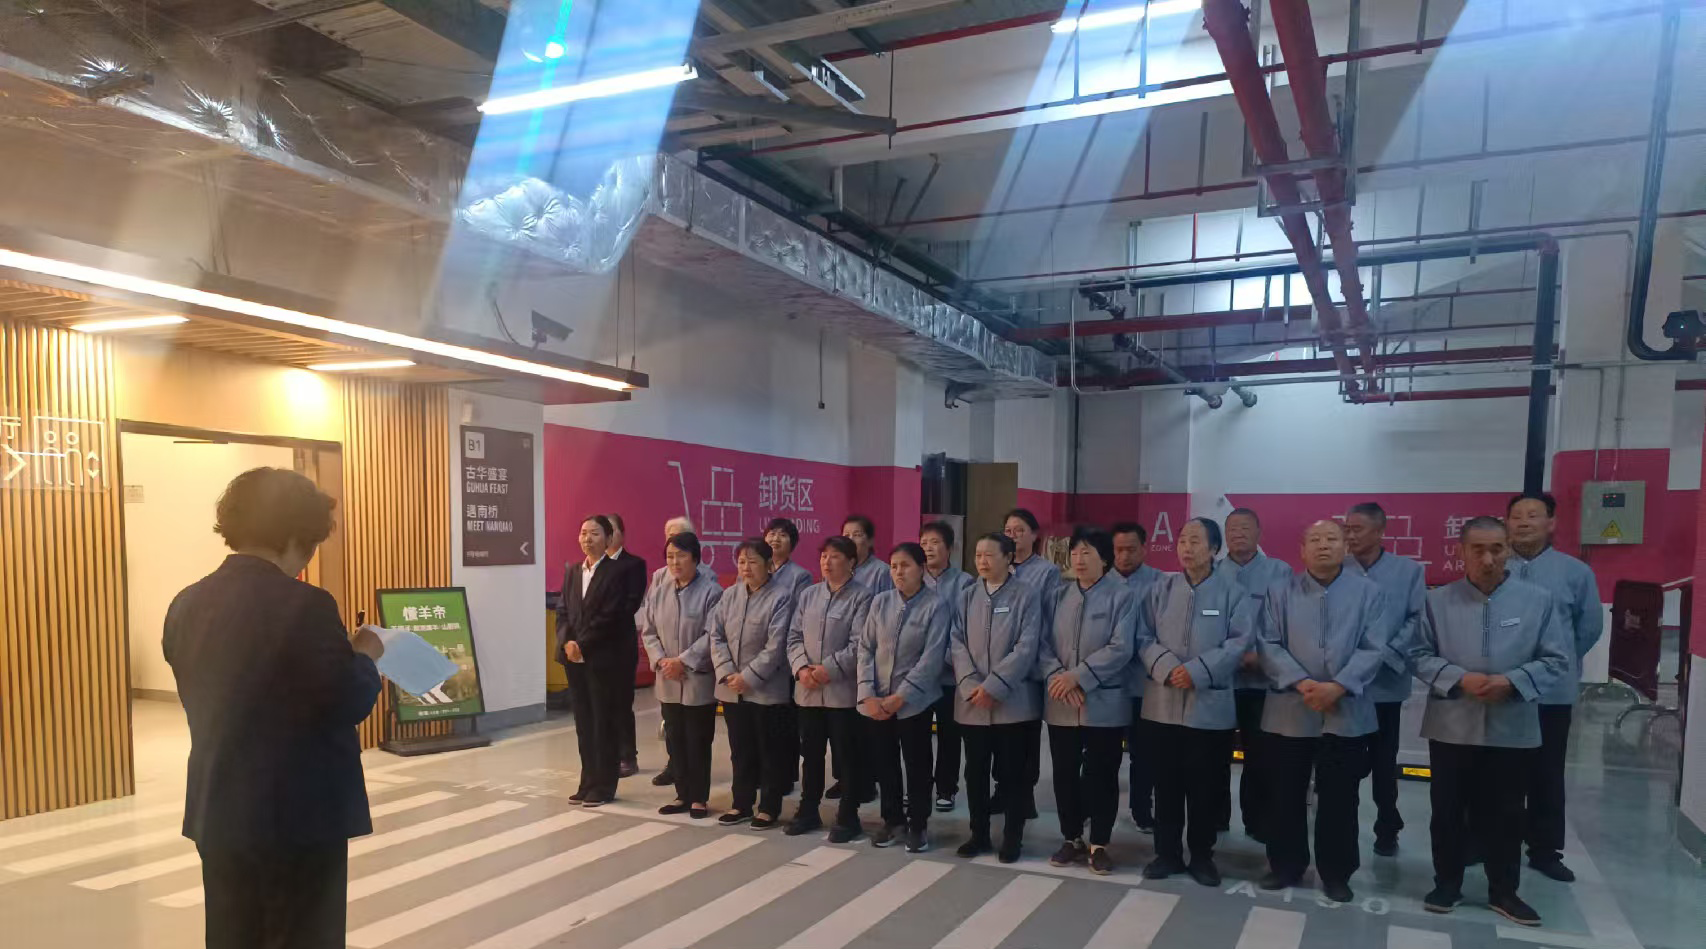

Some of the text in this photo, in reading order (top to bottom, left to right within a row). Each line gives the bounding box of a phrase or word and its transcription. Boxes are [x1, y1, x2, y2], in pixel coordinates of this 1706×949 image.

[468, 439, 481, 451] B1
[465, 465, 508, 481] 古华盛宴
[466, 481, 508, 494] GUHUA FEAST
[759, 473, 813, 511] 卸货区
[467, 520, 484, 531] MEET
[1151, 512, 1173, 543] A
